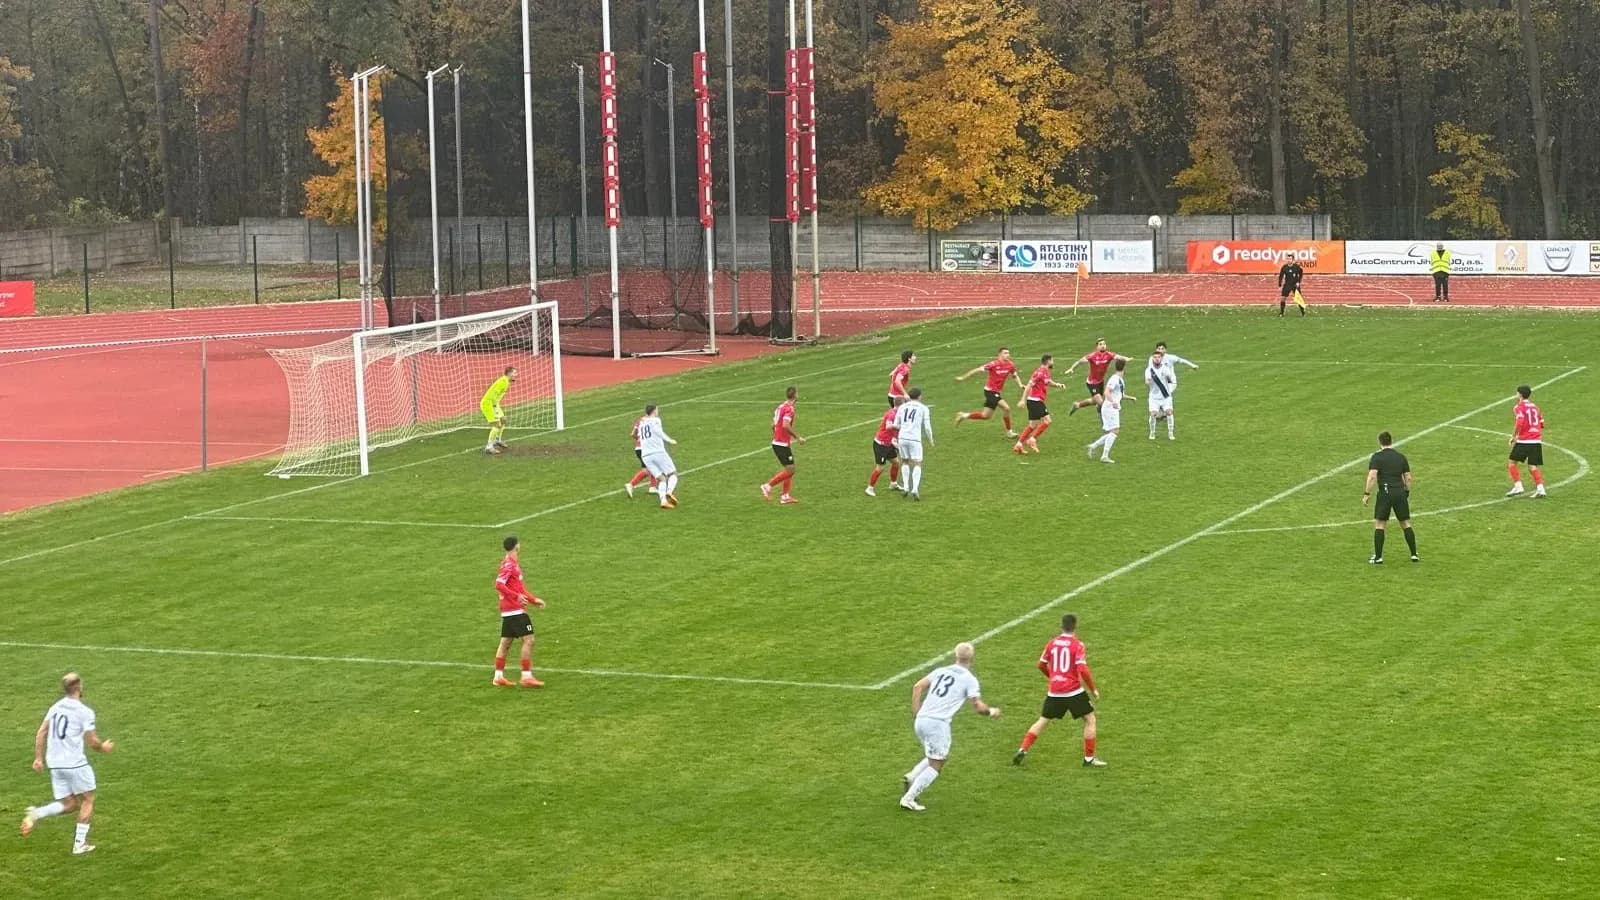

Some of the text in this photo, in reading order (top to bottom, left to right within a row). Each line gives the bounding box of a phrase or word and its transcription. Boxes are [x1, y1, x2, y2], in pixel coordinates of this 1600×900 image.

[1039, 244, 1088, 253] ATLETIKY
[1234, 246, 1317, 264] readymat
[903, 407, 917, 423] 14
[1525, 407, 1539, 426] 13
[640, 424, 652, 440] 18
[1050, 646, 1071, 673] 10
[930, 673, 955, 698] 13
[52, 712, 68, 740] 10
